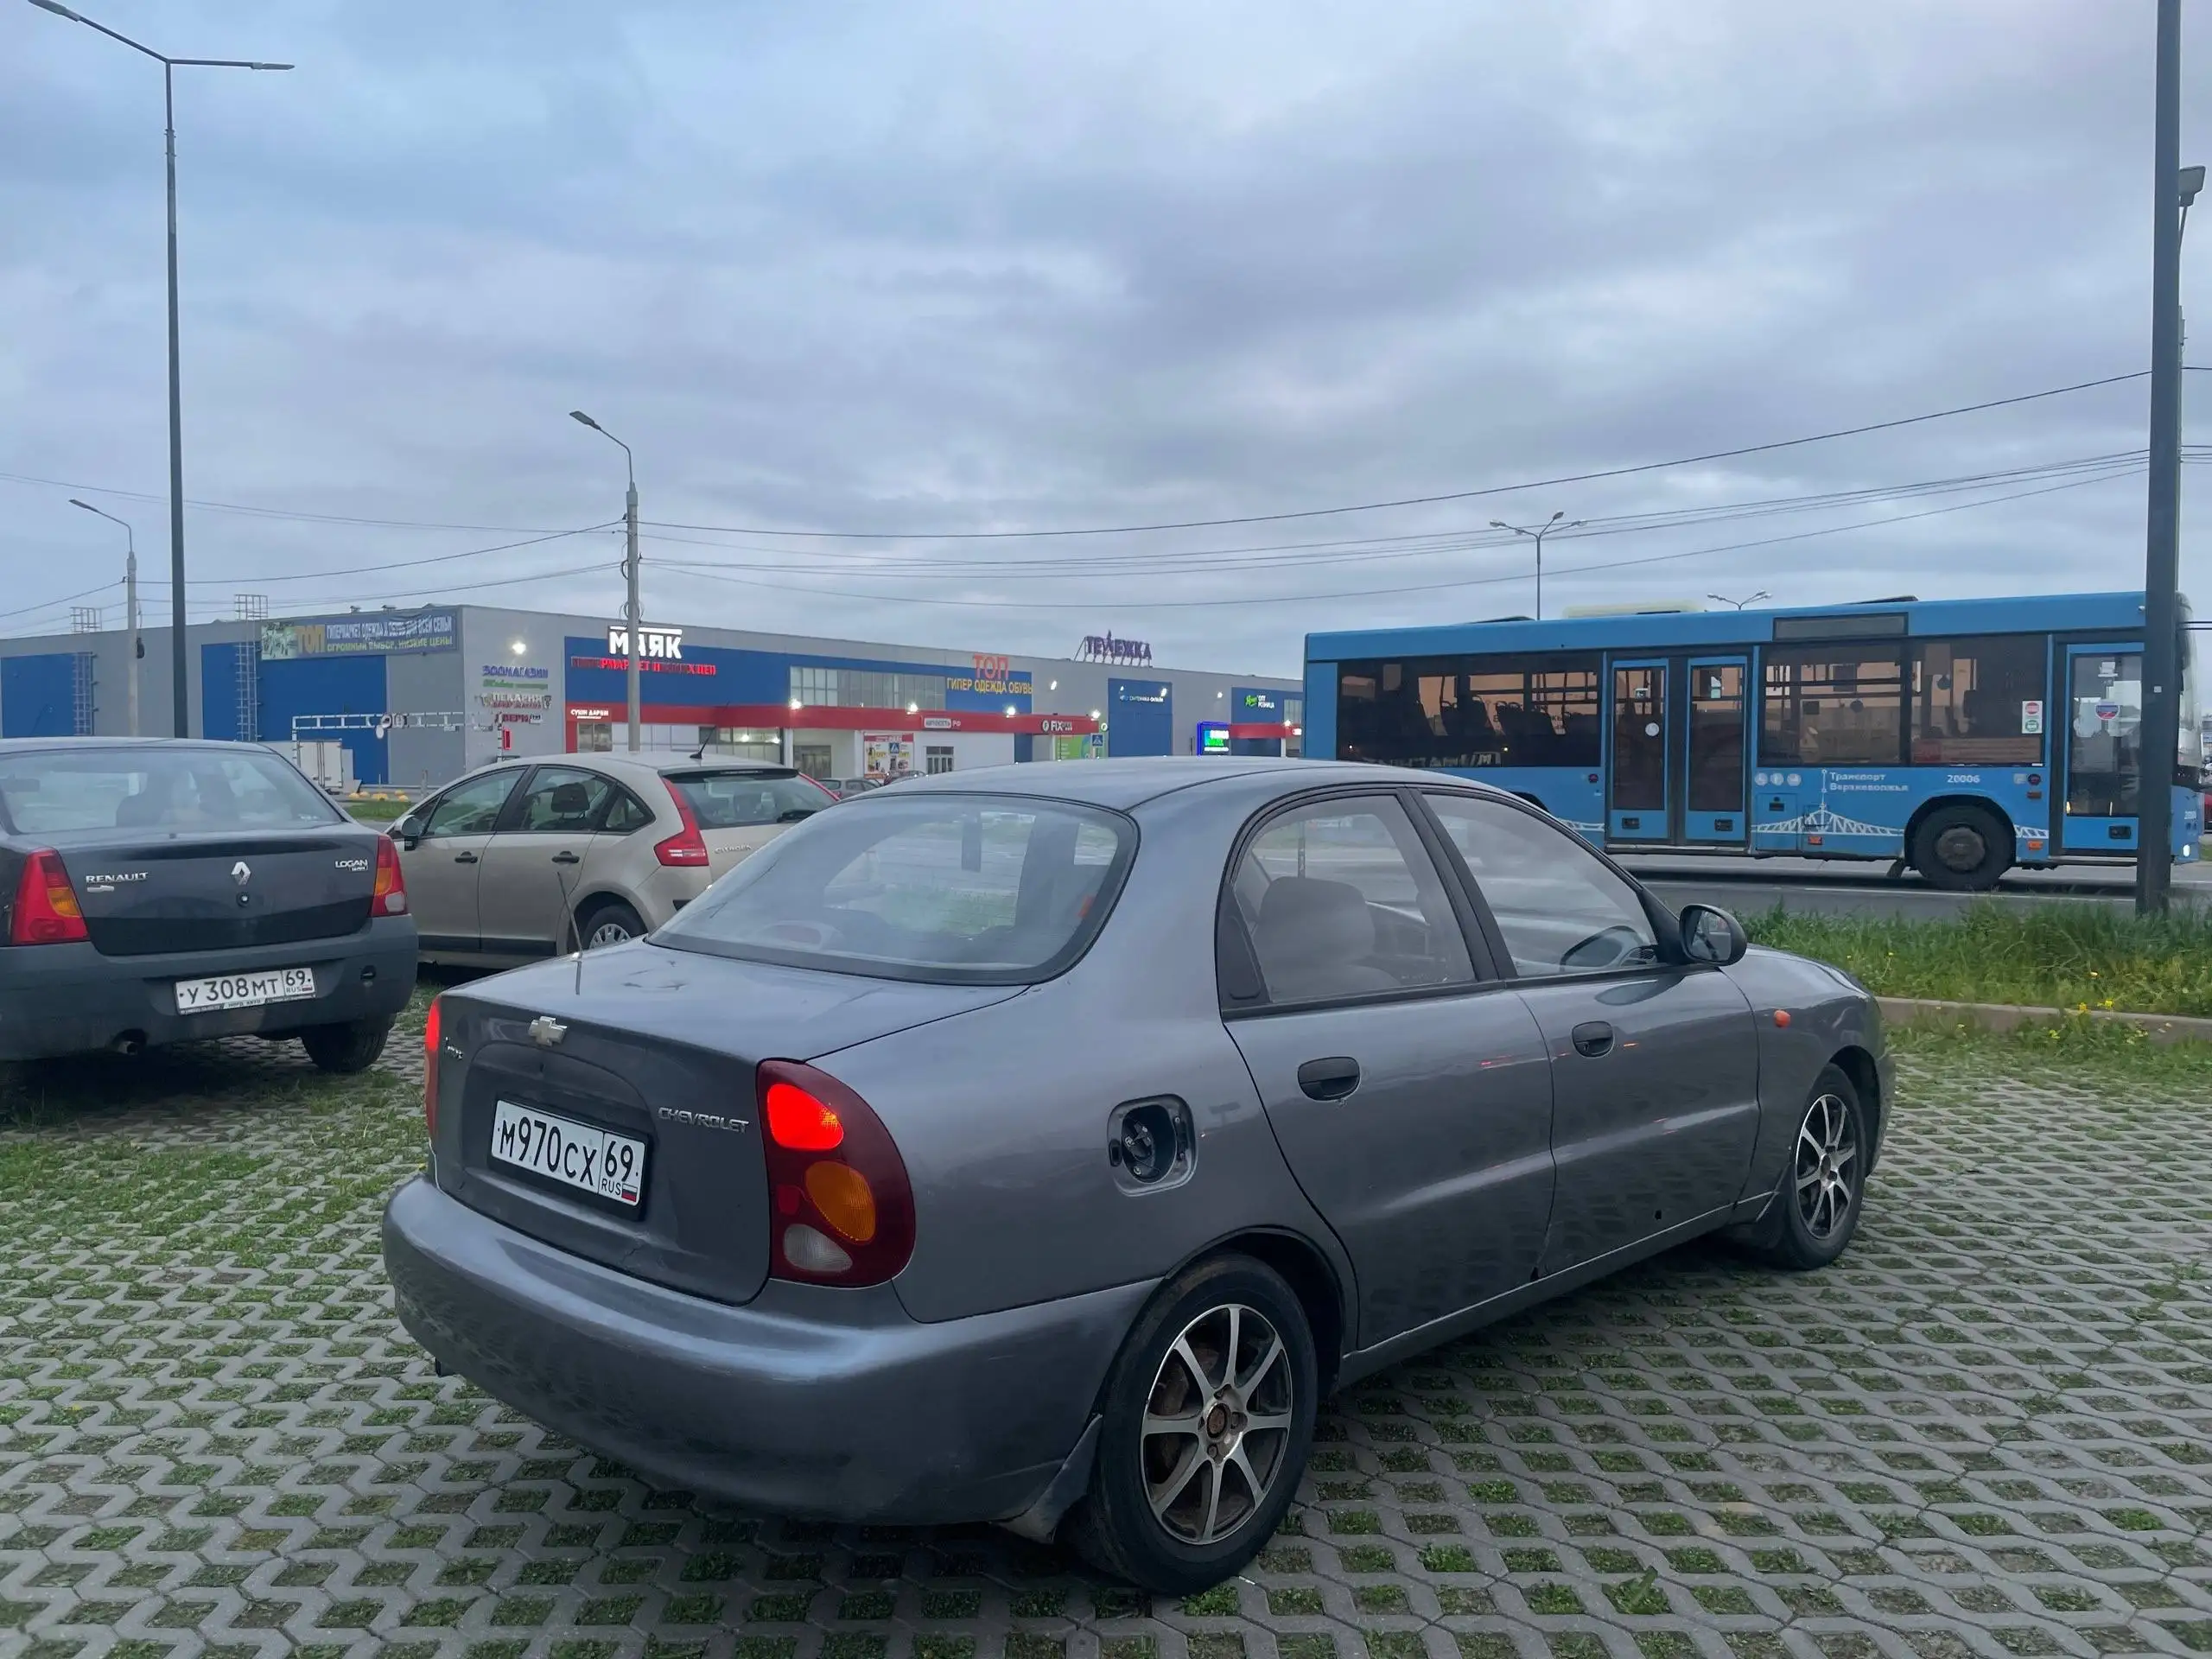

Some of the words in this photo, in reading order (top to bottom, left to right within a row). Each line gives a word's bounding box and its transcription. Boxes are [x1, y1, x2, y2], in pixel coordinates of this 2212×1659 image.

[974, 653, 1009, 680] ТОП
[946, 677, 972, 691] ГИПЕР
[974, 679, 1007, 695] ОДЕЖДА
[1008, 682, 1033, 695] ОБУВЬ
[1829, 772, 1887, 782] Транспорт
[334, 859, 368, 868] LOGAN
[86, 872, 149, 883] RENAULT
[285, 969, 306, 987] 69
[658, 1107, 749, 1135] CHEVROLET
[604, 1140, 633, 1182] 69
[601, 1178, 621, 1196] RUS
